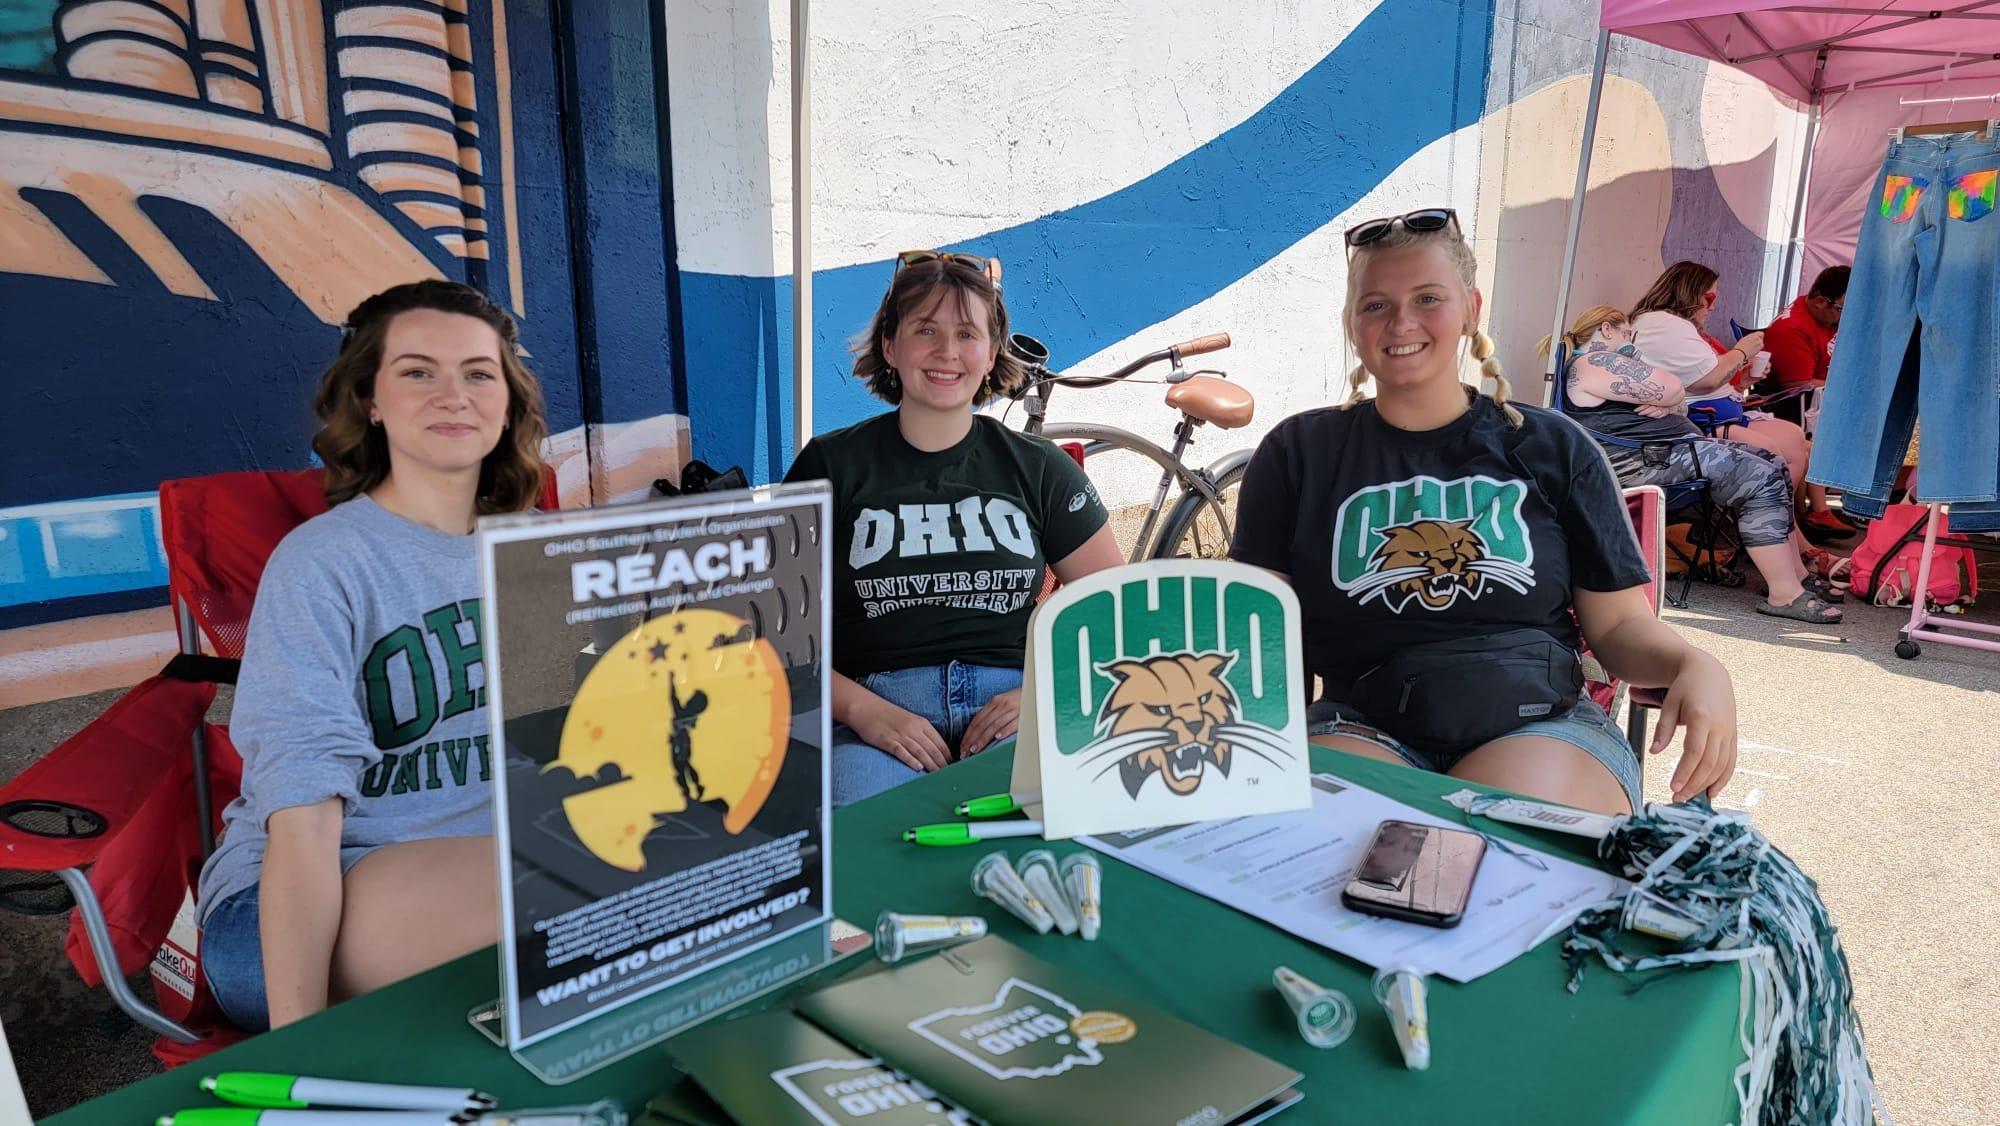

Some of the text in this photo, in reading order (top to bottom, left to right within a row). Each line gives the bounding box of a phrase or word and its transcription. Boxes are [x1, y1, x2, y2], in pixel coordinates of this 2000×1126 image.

[543, 514, 786, 557] OHIO Southern Student Organization
[849, 496, 1036, 570] OHIO
[1332, 475, 1535, 590] OHIO
[571, 536, 769, 603] REACH
[855, 568, 1036, 599] UNIVERSITY
[363, 597, 488, 750] OH
[1051, 576, 1290, 756] OHIO
[536, 886, 811, 1008] WANT TO GET INVOLVED?
[958, 1004, 1042, 1040] FOREVER
[976, 1012, 1069, 1056] OHIO
[836, 1080, 923, 1117] OHI
